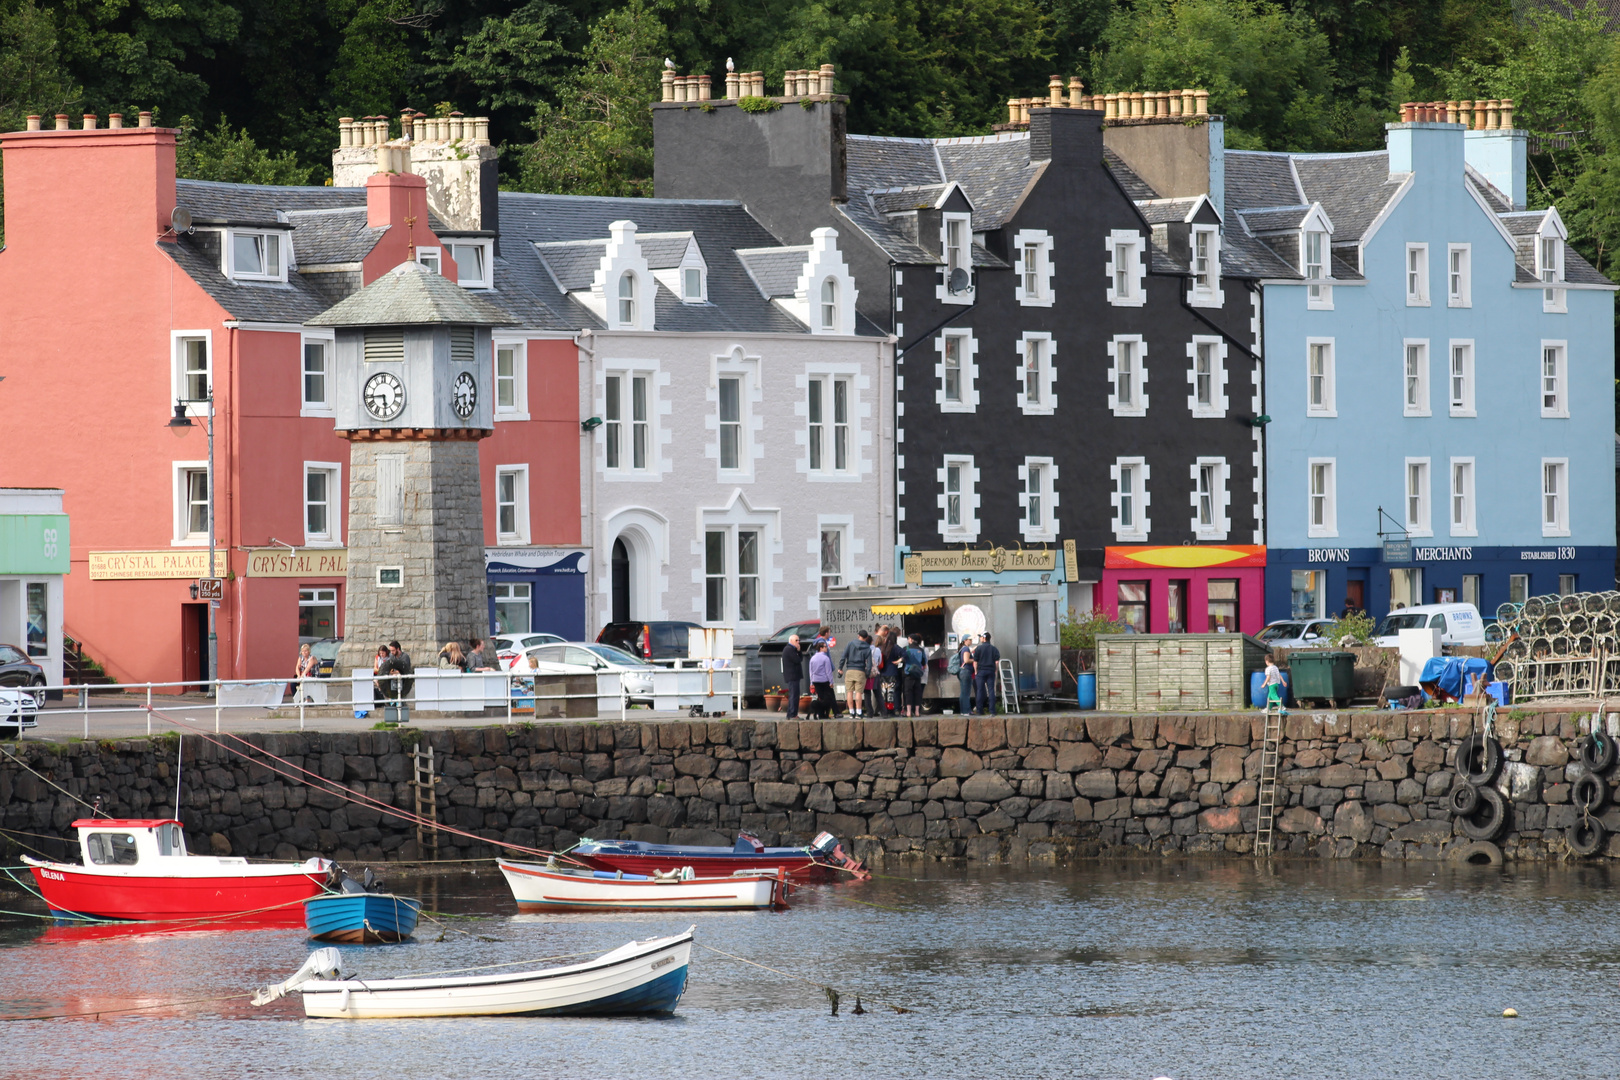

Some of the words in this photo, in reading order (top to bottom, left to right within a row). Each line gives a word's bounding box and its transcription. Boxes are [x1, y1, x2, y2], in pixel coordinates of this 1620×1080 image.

[1011, 554, 1024, 566] TEA
[1028, 554, 1050, 566] ROOM
[1308, 548, 1350, 562] BROWNS
[1415, 547, 1472, 561] MERCHANTS
[1521, 551, 1557, 560] ESTABLISHED
[1558, 546, 1576, 560] 1830
[108, 555, 156, 570] CRYSTAL
[163, 556, 205, 568] PALACE
[253, 554, 312, 573] CRYSTAL
[921, 558, 959, 568] OBERMORY
[962, 554, 990, 567] BAKERY
